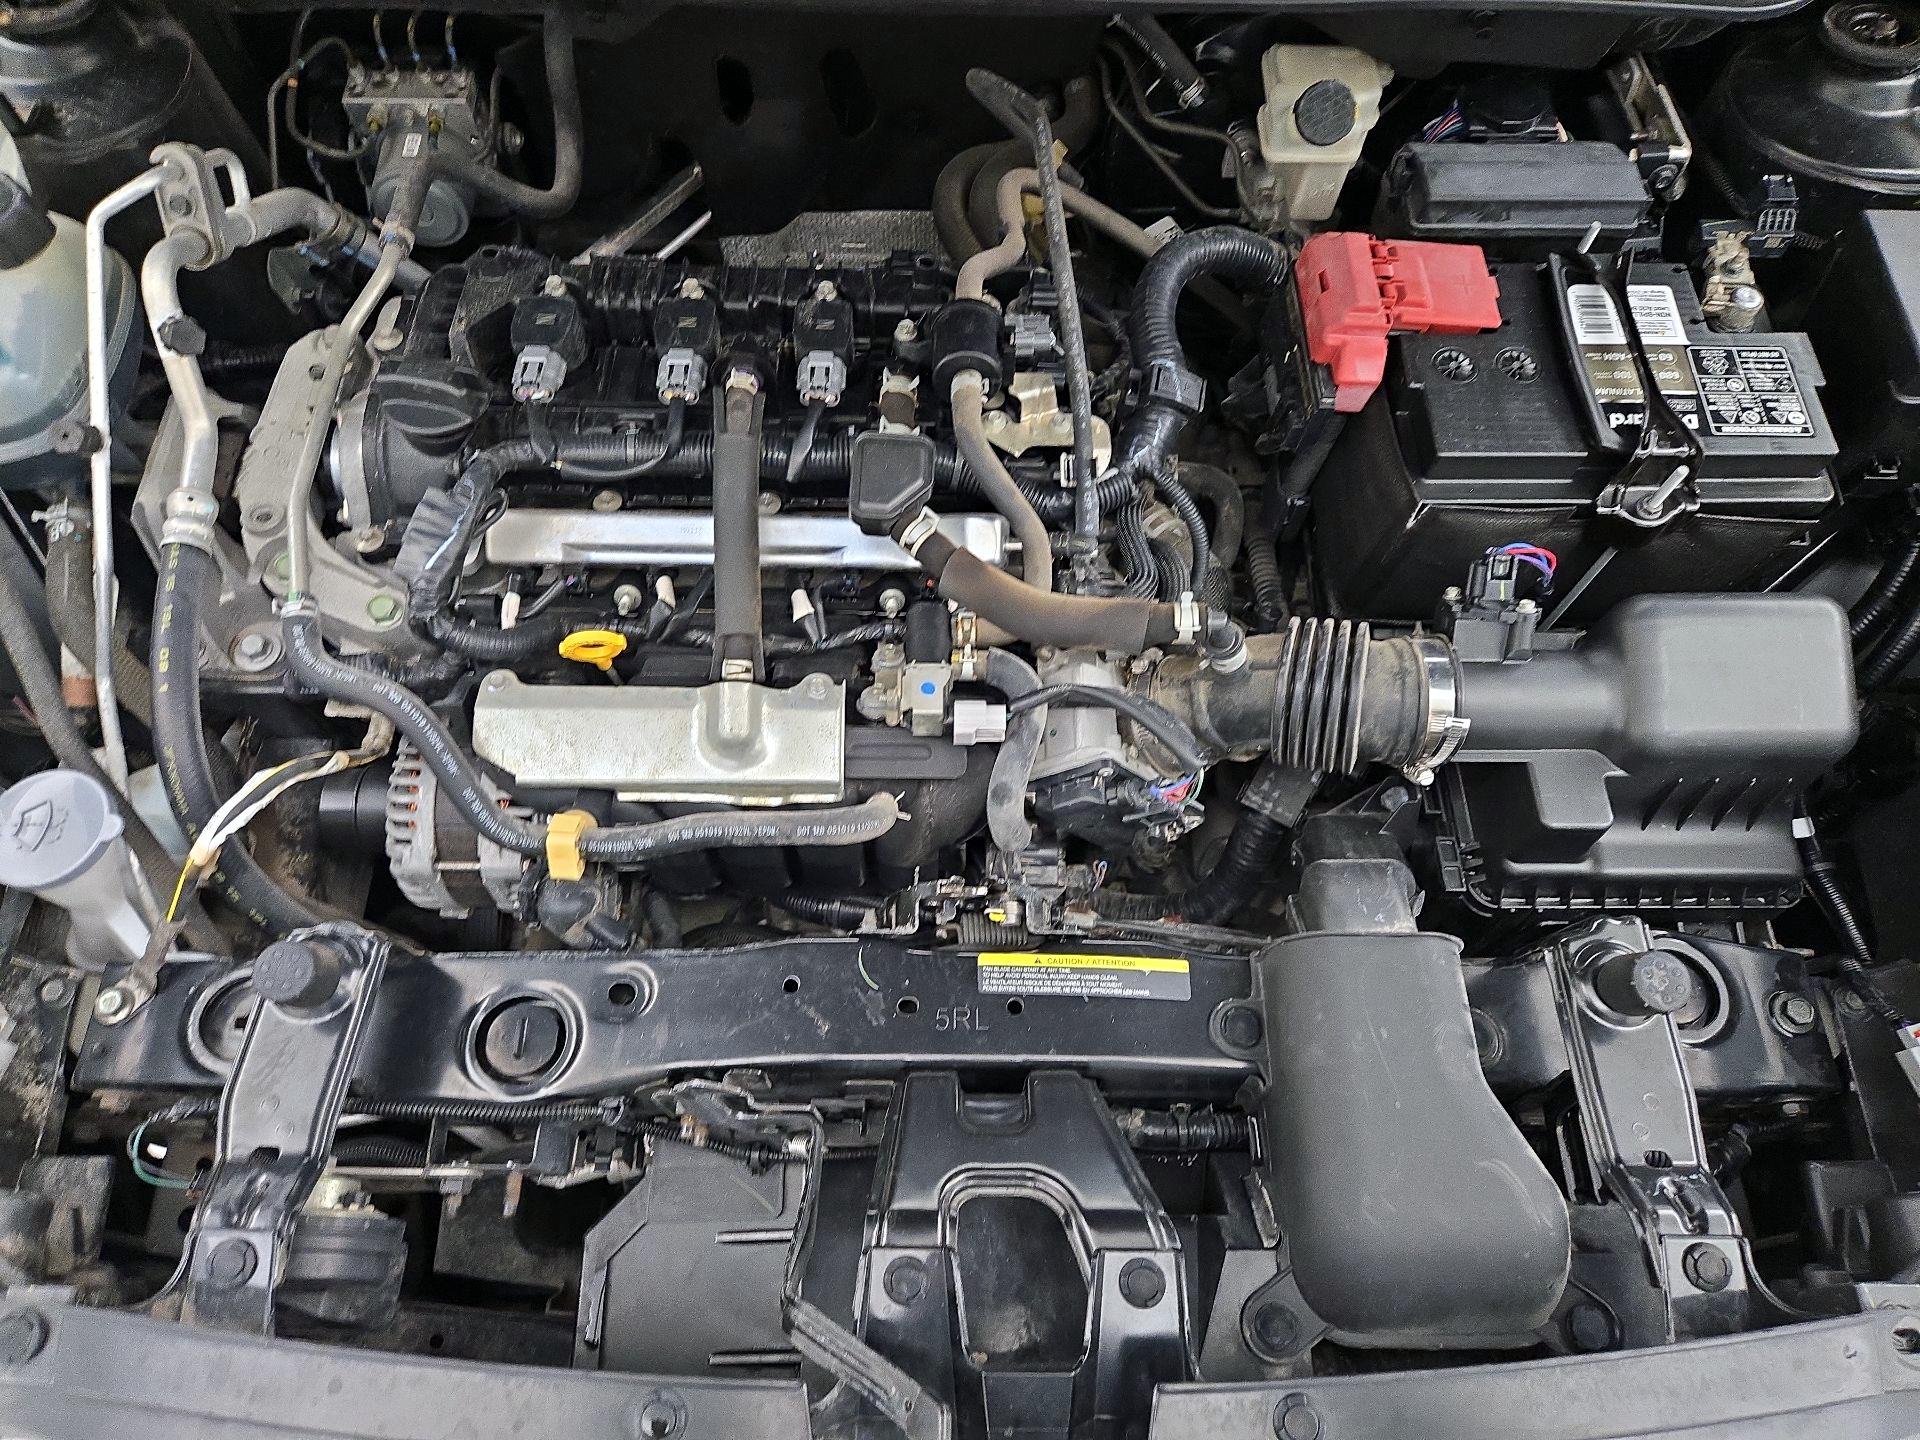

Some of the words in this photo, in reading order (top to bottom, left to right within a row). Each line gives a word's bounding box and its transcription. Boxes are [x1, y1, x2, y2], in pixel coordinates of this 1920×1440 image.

[1047, 957, 1083, 965] CAUTION
[1092, 958, 1136, 967] ATTENTION
[935, 1006, 990, 1032] 5RL
